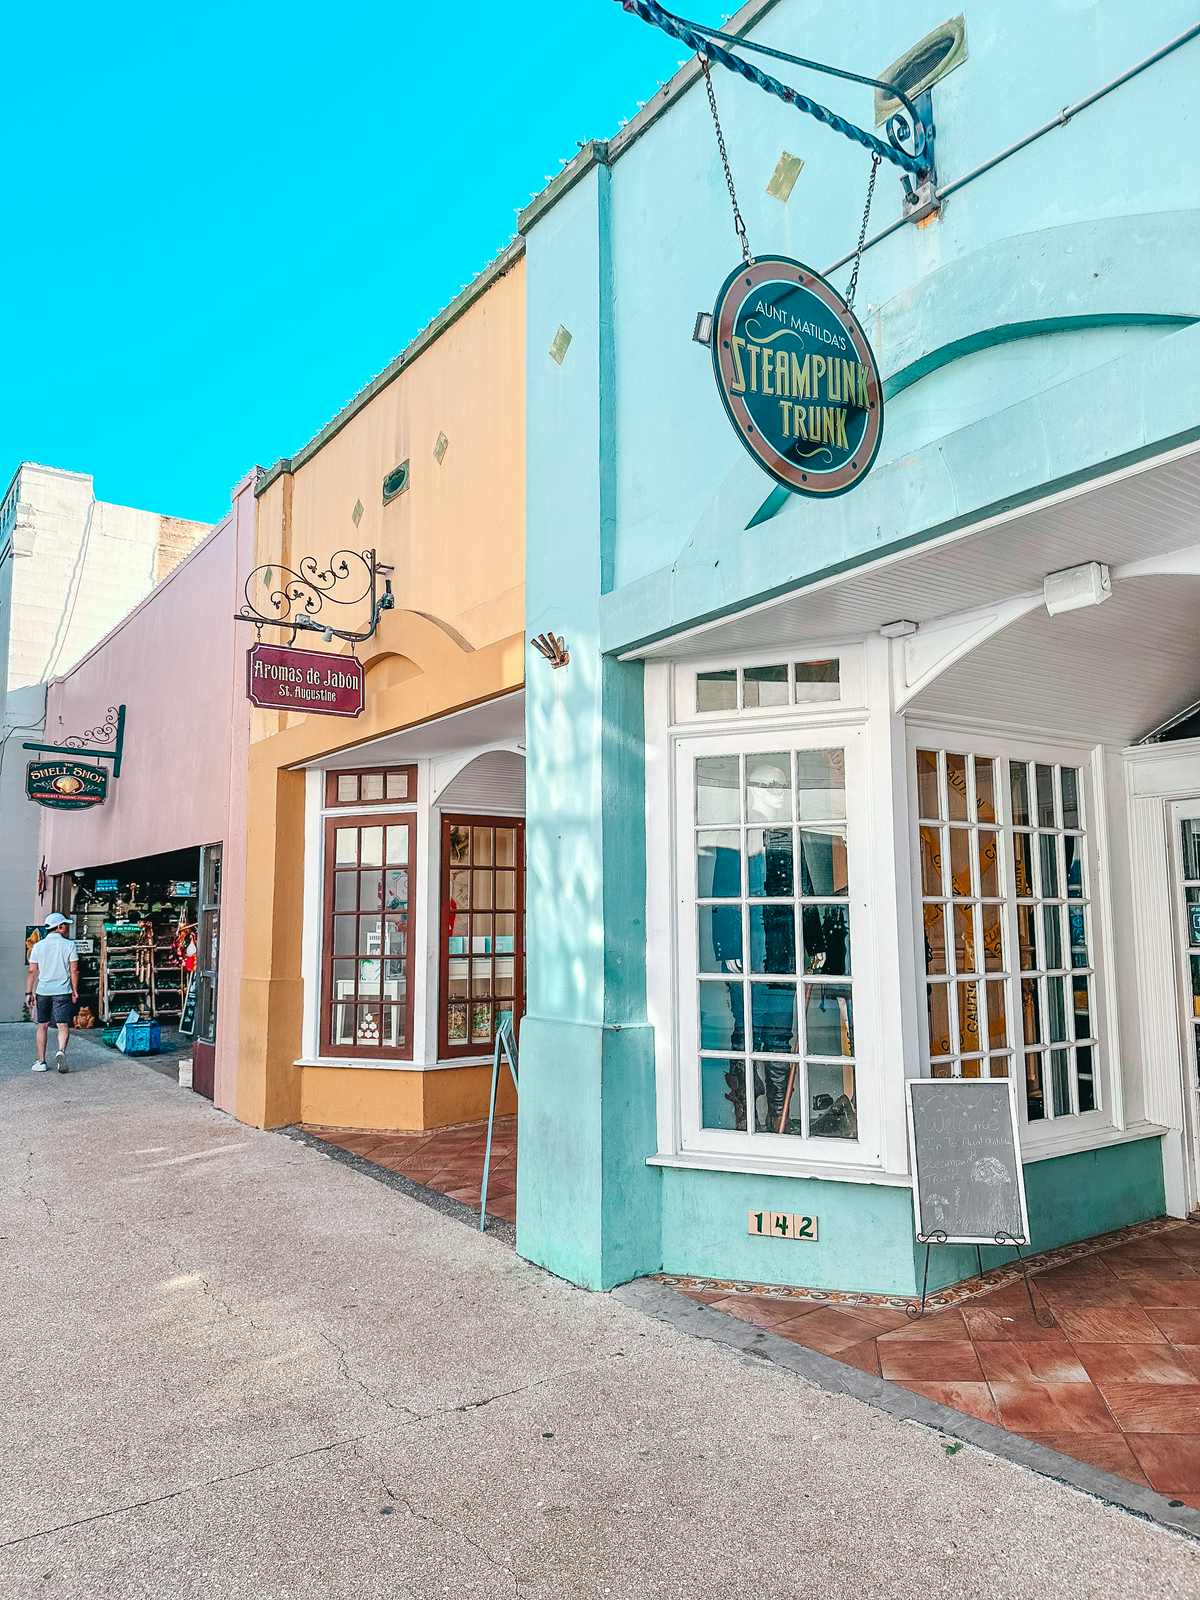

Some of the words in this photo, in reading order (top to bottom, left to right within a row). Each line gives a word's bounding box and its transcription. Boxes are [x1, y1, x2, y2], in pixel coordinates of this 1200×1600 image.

[755, 300, 787, 324] AUNT
[790, 316, 846, 351] MATILDA'S
[730, 335, 872, 412] STEAMPUNK
[779, 400, 849, 450] TRUNK
[254, 660, 303, 683] Aromas
[306, 667, 321, 685] de
[323, 669, 359, 690] Jabón
[278, 684, 293, 697] St.
[295, 686, 337, 702] Augustine
[30, 766, 70, 780] SHELL
[73, 767, 105, 783] SHOP
[754, 1212, 814, 1238] 142
